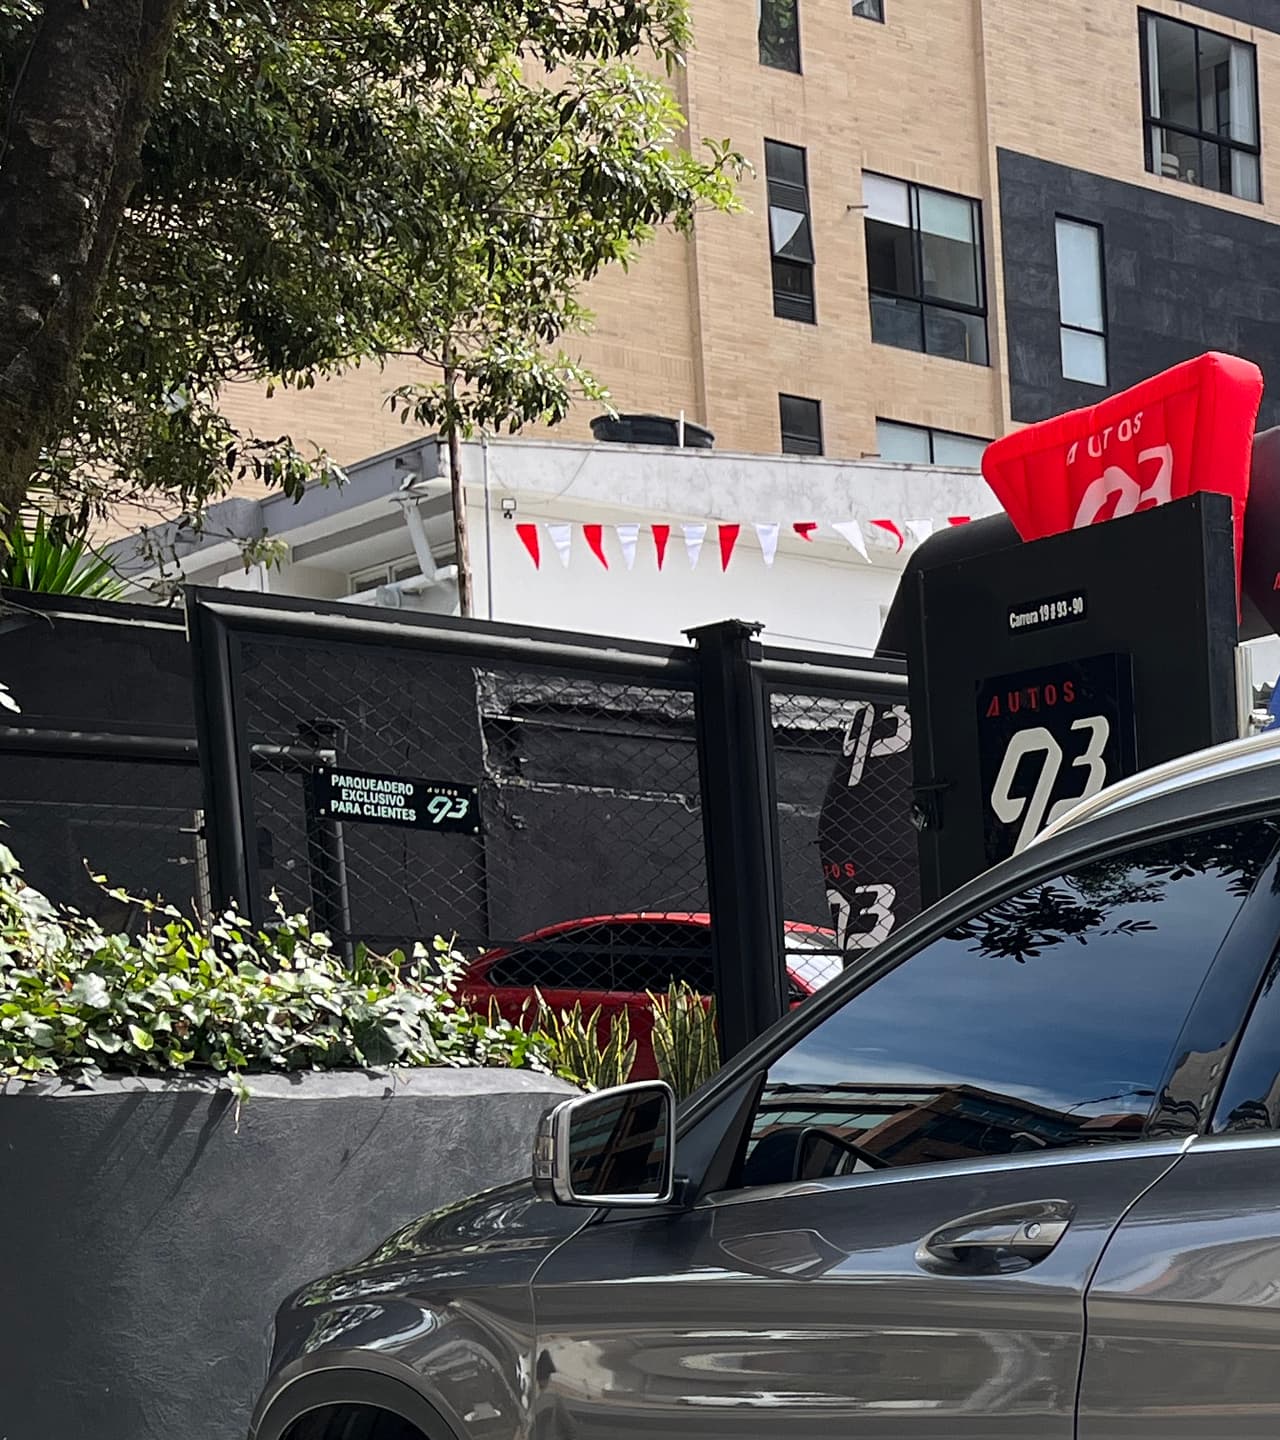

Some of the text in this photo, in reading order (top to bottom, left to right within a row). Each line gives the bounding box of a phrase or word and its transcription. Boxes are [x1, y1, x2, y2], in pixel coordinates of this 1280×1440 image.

[1066, 411, 1144, 466] AUTOS
[1009, 611, 1039, 629] Carrera
[1039, 604, 1050, 622] 19
[986, 680, 1076, 718] AUTOS
[331, 774, 414, 796] PARQUEADERO
[341, 789, 405, 808] EXCLUSIVO
[990, 714, 1110, 856] 93
[330, 800, 417, 822] PARA CLIENTES
[426, 795, 470, 824] 93
